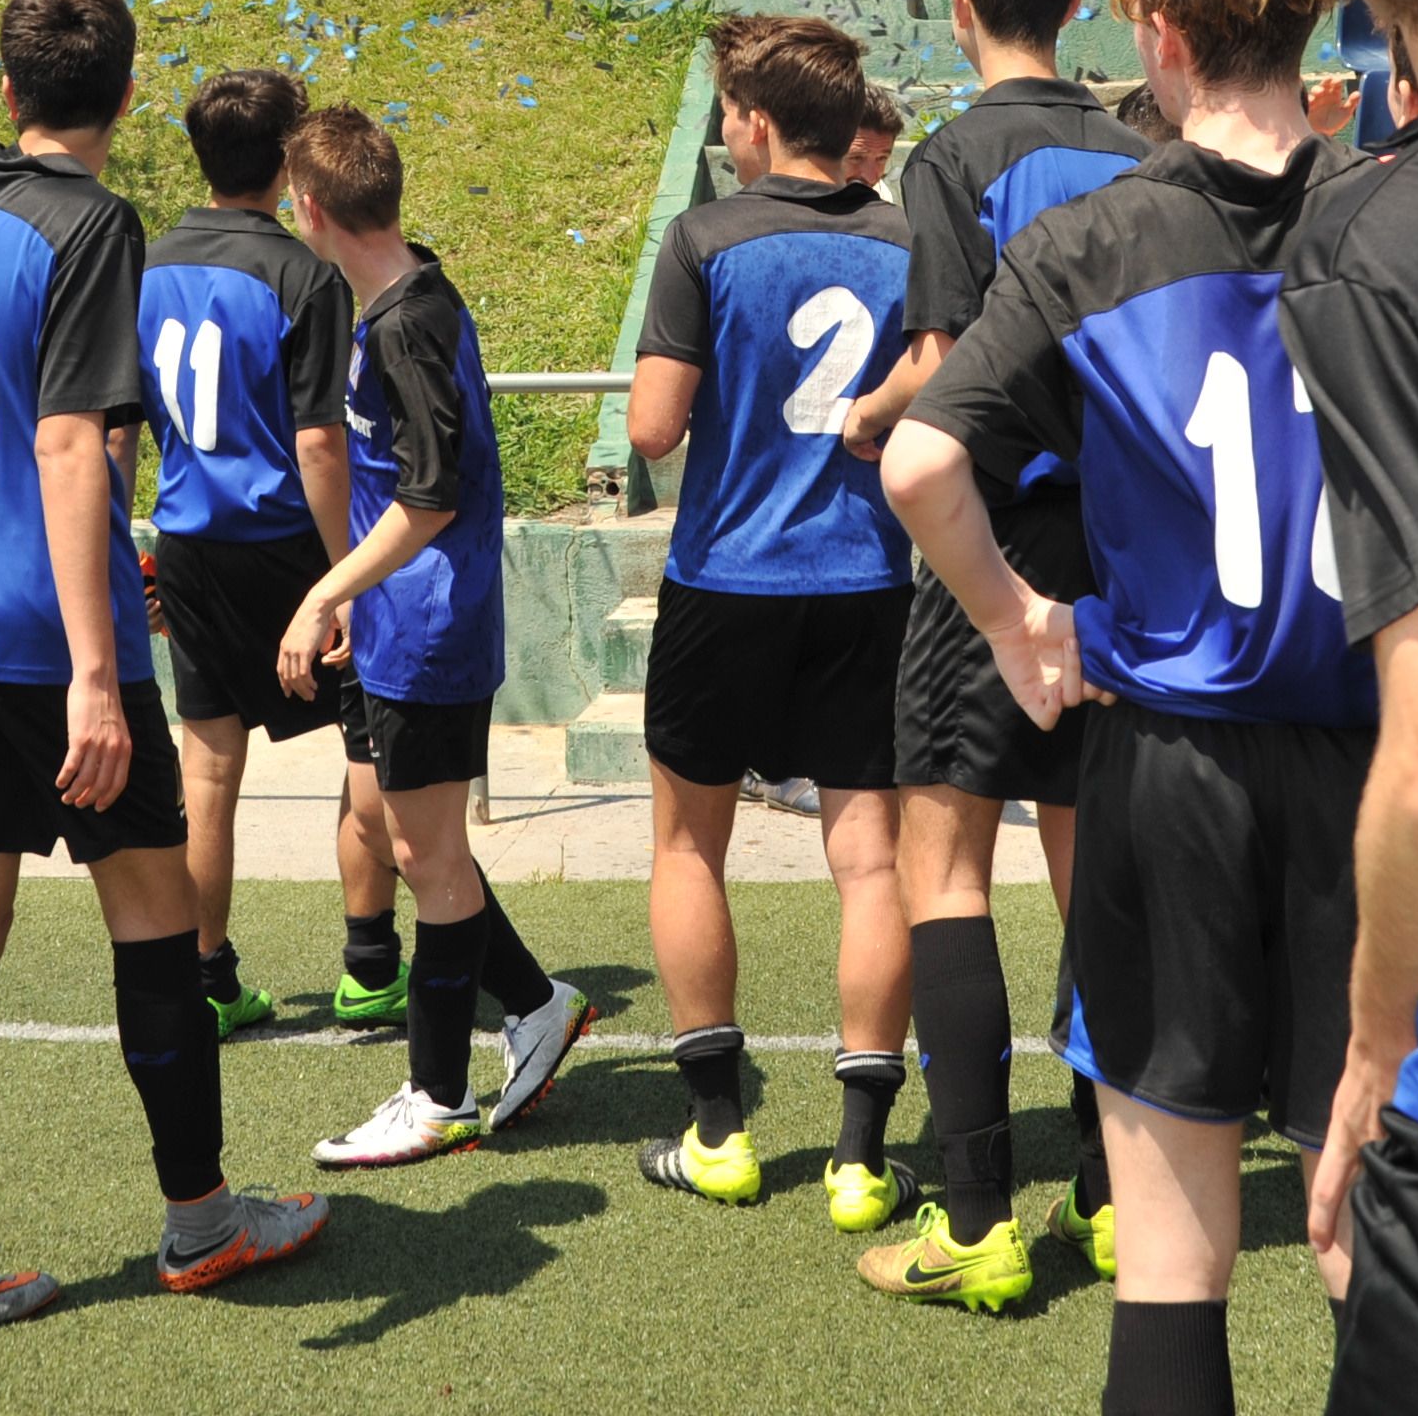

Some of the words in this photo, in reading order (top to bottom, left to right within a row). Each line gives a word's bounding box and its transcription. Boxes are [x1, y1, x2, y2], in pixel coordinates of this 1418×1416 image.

[153, 317, 222, 452] 11
[783, 285, 875, 435] 2
[1184, 351, 1343, 608] 1
